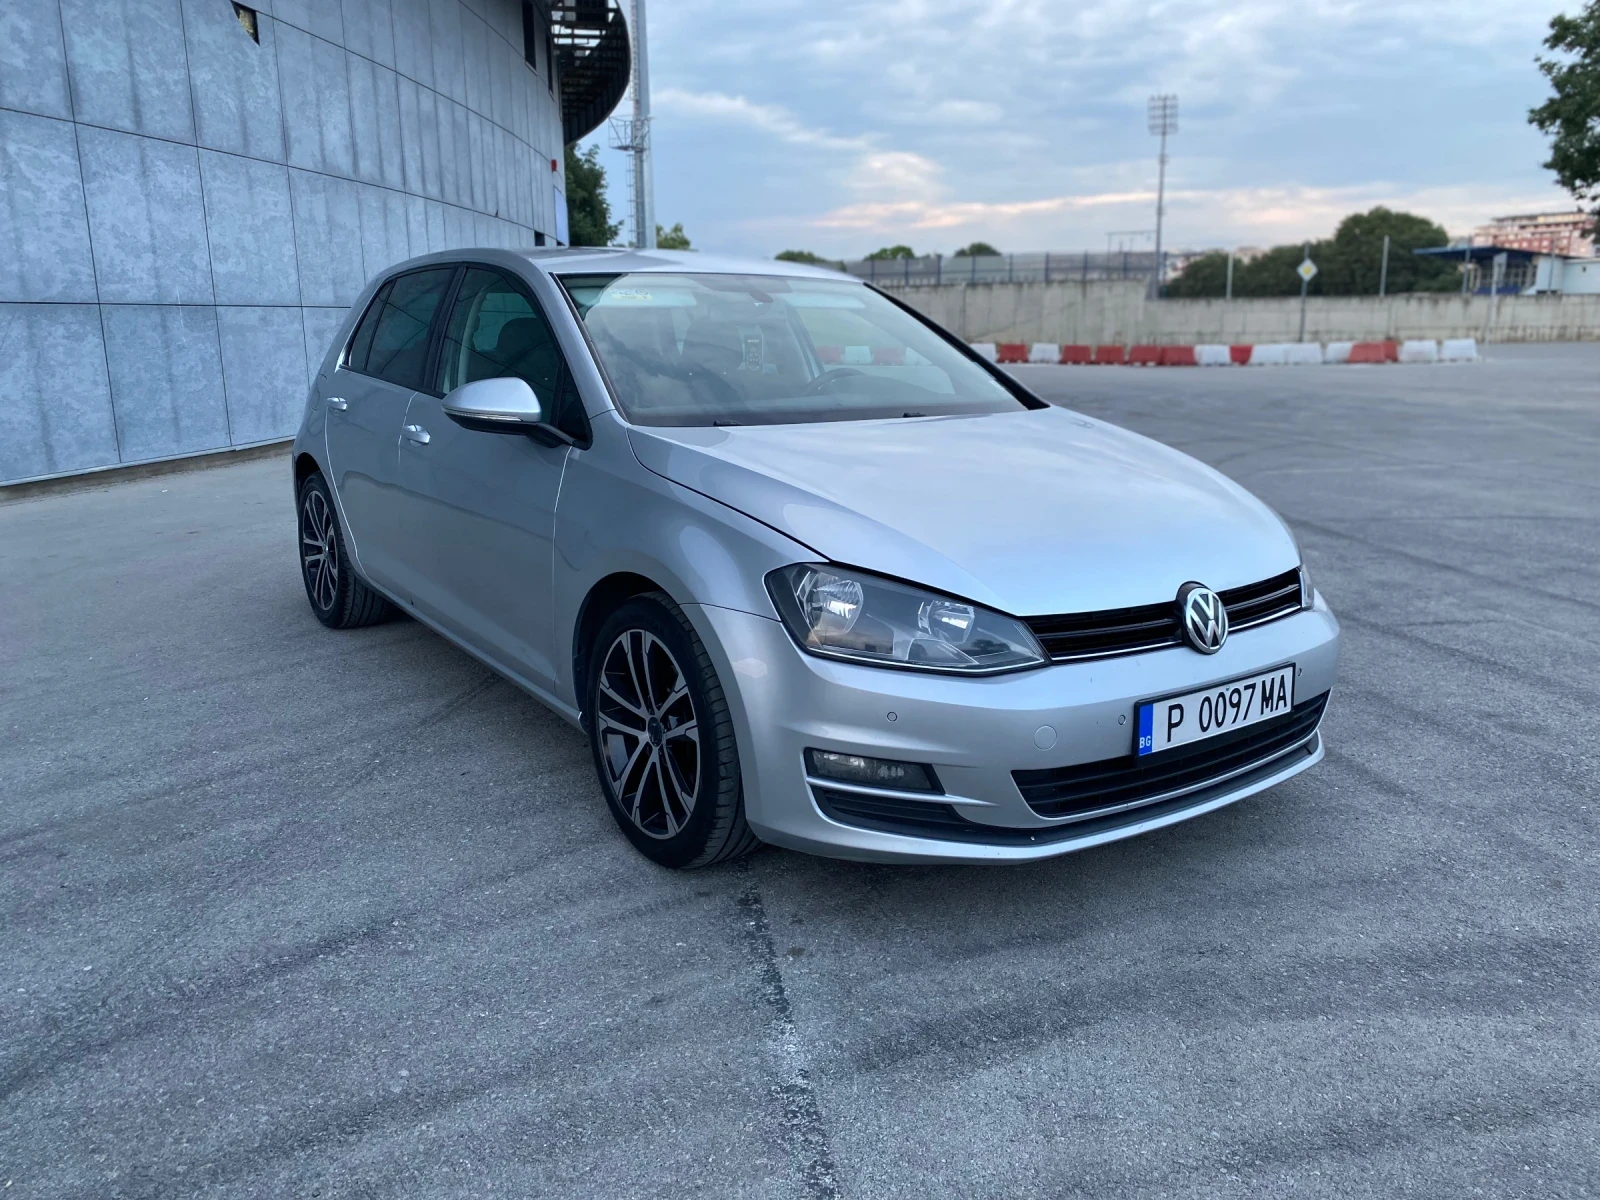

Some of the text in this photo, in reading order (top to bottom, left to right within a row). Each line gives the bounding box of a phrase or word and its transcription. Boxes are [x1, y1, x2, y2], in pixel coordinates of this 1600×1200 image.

[1186, 588, 1227, 652] VW
[1167, 674, 1288, 743] P 0097 MA
[1139, 735, 1152, 749] BG
